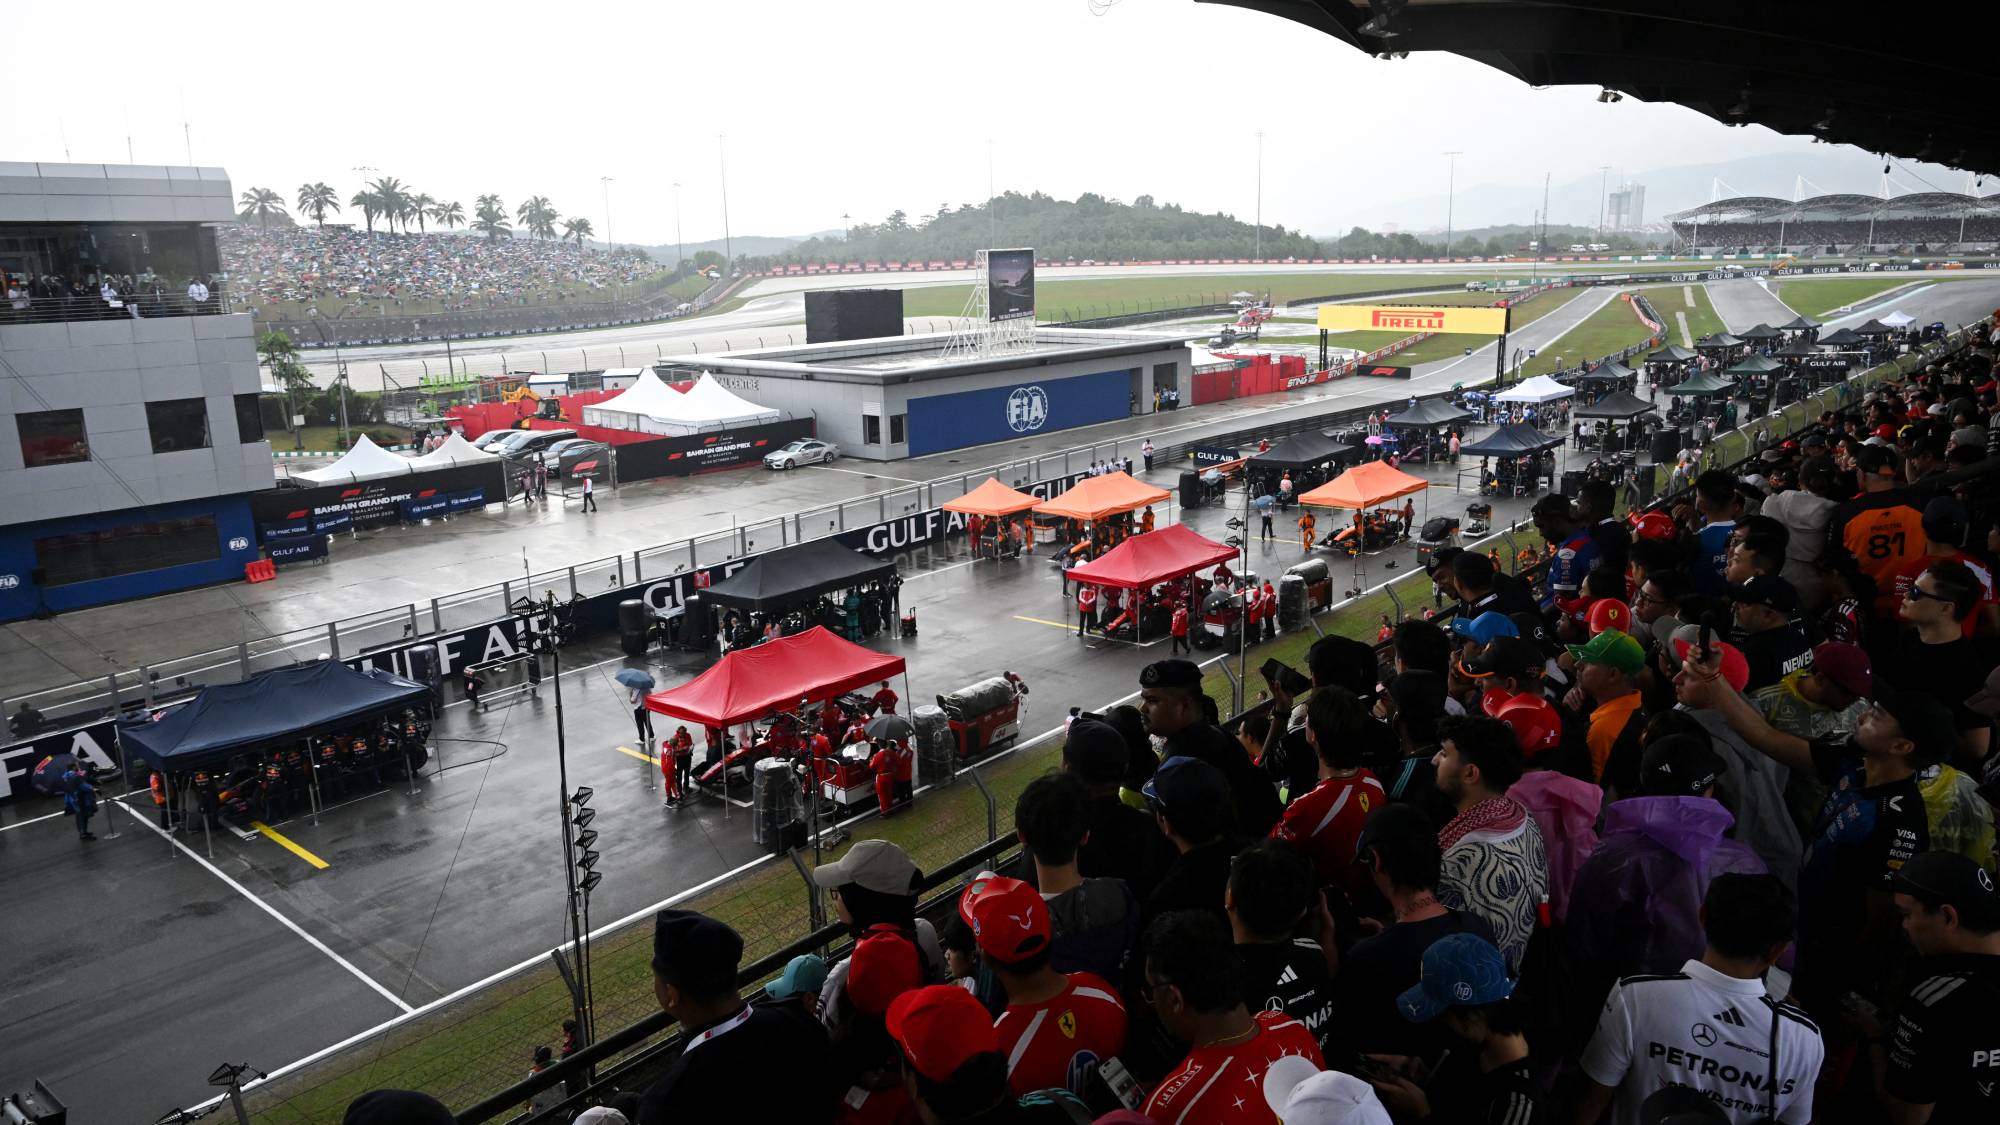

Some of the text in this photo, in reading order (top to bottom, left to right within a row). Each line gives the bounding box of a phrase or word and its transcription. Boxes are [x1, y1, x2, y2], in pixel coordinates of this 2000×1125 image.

[1372, 310, 1445, 328] PIRELLI
[686, 448, 714, 457] BAHRAIN
[715, 444, 736, 452] GRAND
[1198, 451, 1234, 462] GULF AIR
[314, 502, 357, 514] BAHRAIN
[358, 497, 390, 508] GRAND
[390, 493, 411, 503] PRIX
[867, 511, 940, 552] GULF
[272, 548, 294, 556] GULF
[1868, 532, 1905, 559] 81
[1896, 829, 1917, 840] VISA
[1456, 983, 1471, 999] hp
[1649, 1041, 1796, 1095] PETRONAS
